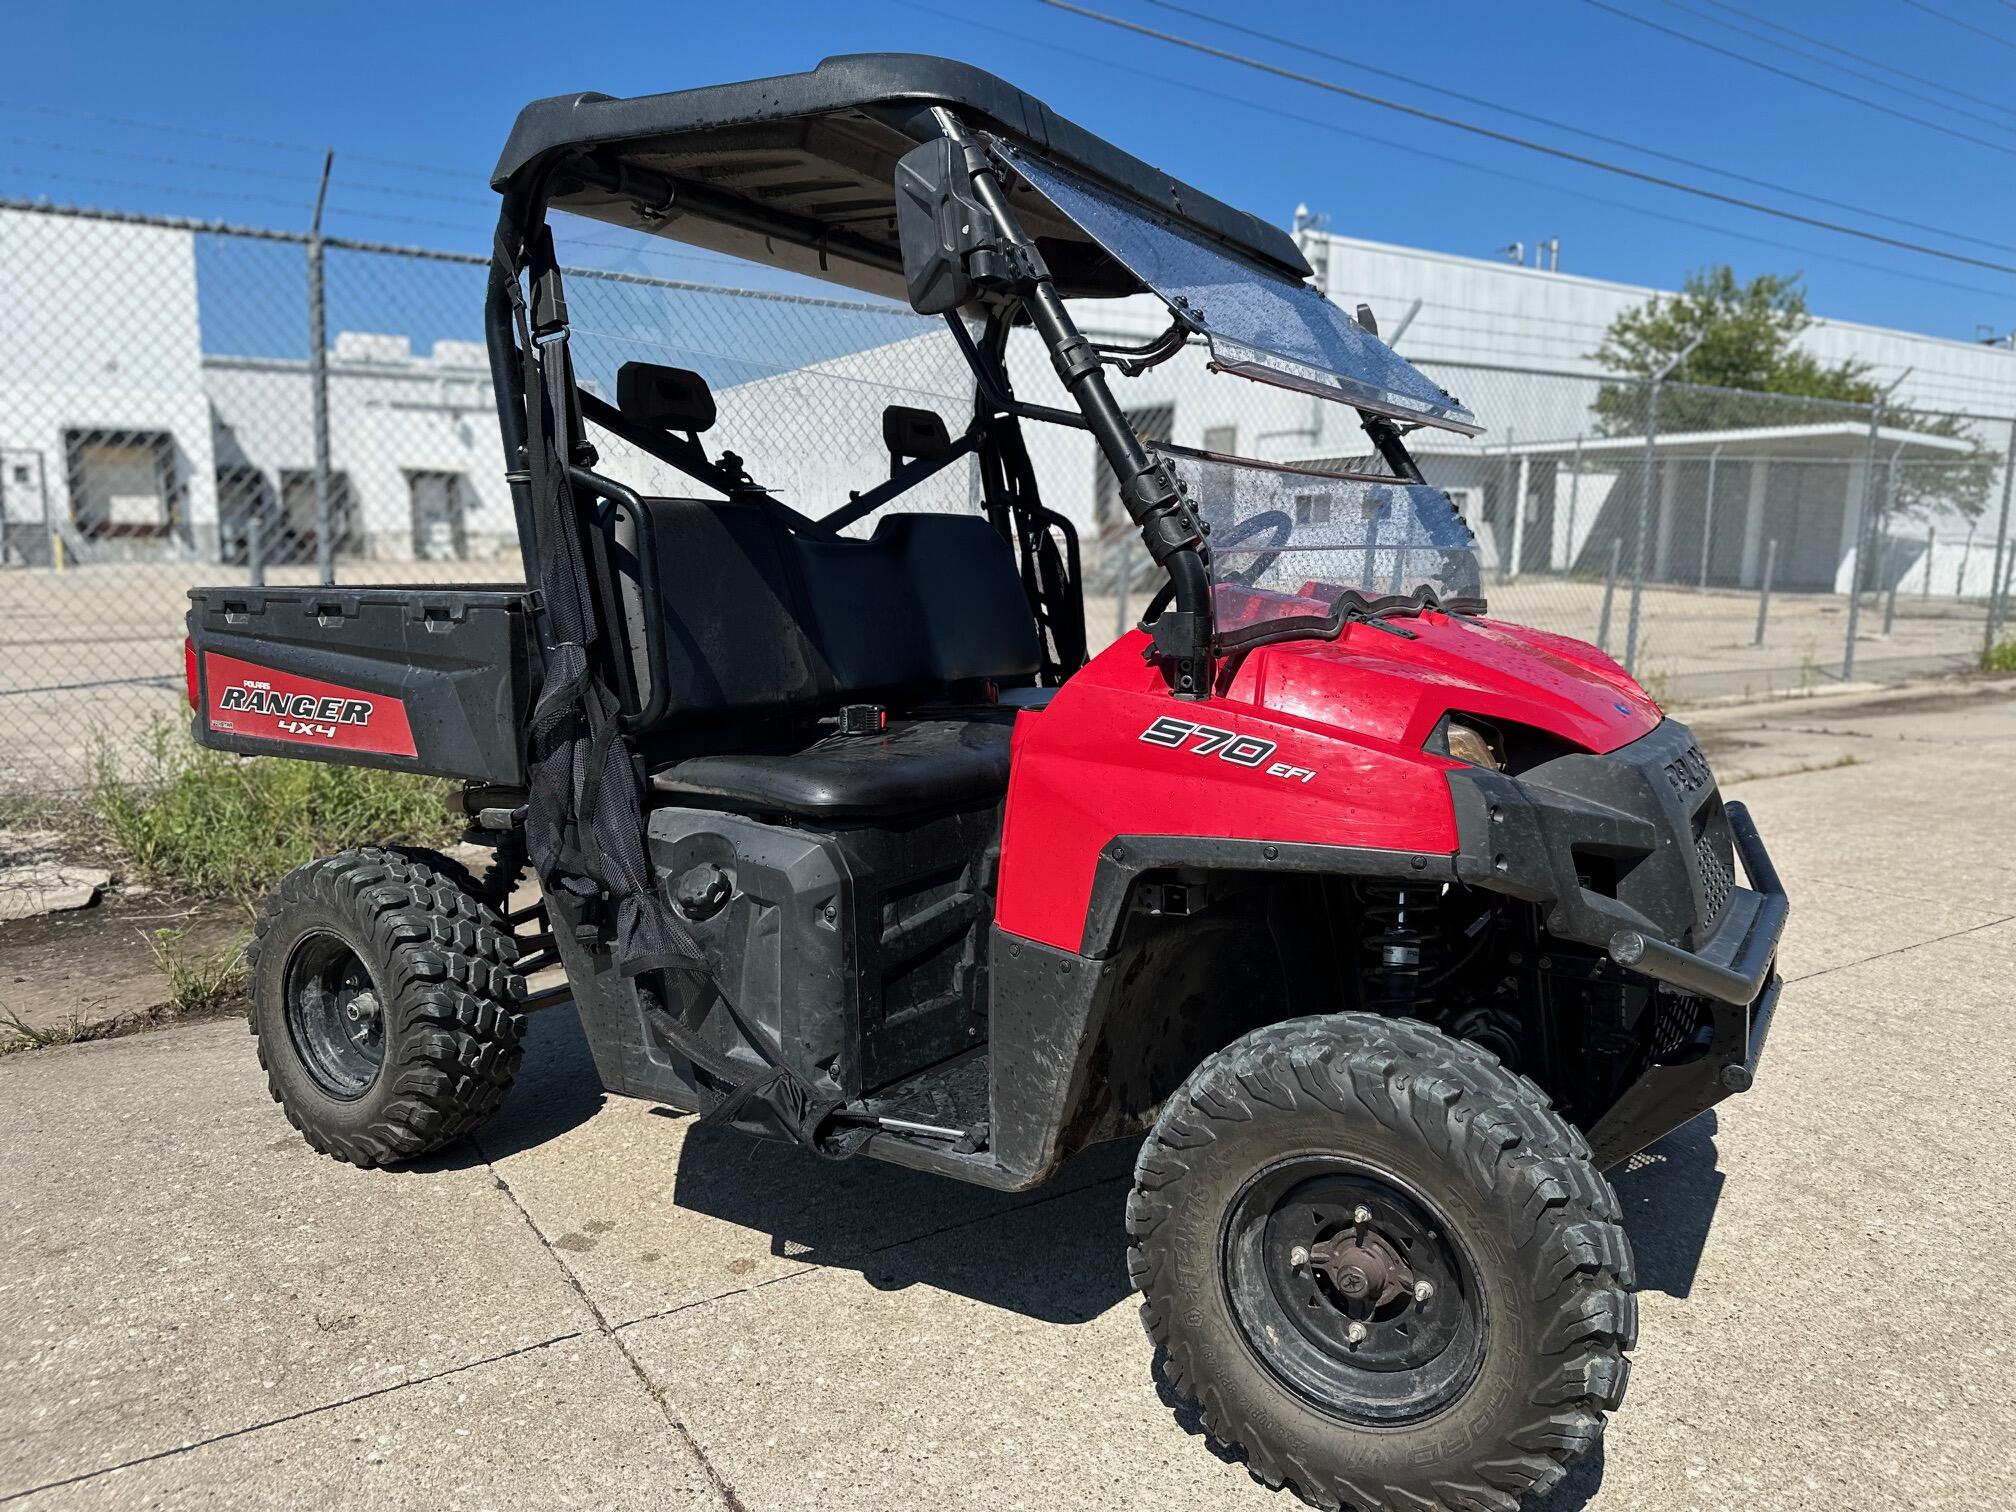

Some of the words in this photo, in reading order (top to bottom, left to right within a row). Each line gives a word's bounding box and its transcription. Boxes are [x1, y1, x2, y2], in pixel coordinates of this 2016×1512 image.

[243, 680, 270, 690] POLARIS
[220, 686, 373, 725] RANGER
[1138, 715, 1278, 767] 570
[1266, 762, 1317, 783] EFI
